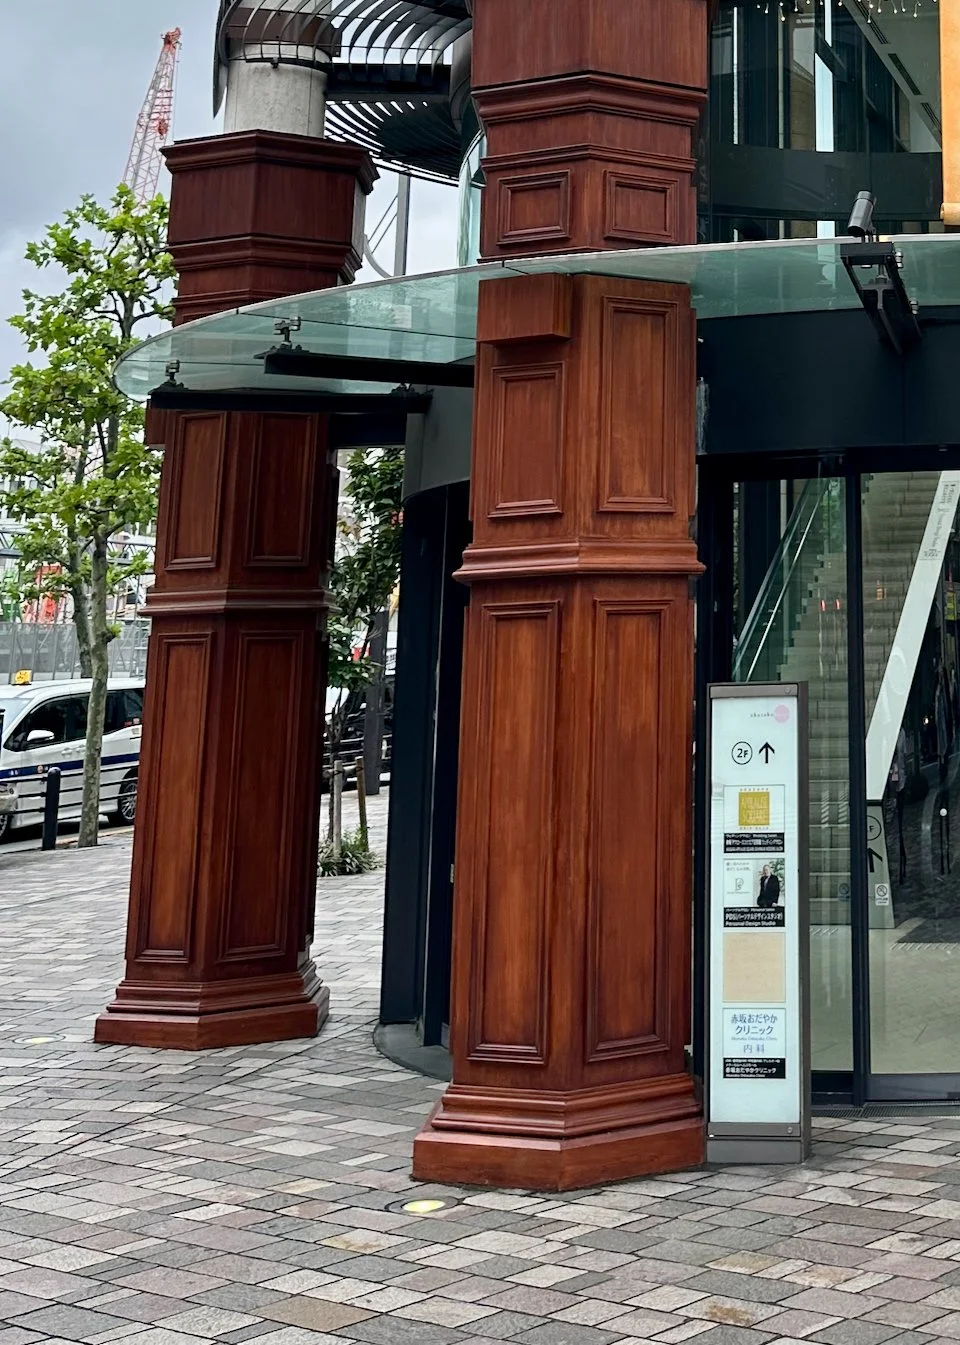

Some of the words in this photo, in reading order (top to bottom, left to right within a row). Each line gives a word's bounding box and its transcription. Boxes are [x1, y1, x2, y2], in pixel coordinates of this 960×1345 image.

[737, 748, 749, 758] 2F
[731, 1013, 778, 1024] 赤坂おだやか
[735, 1025, 774, 1035] クリニック
